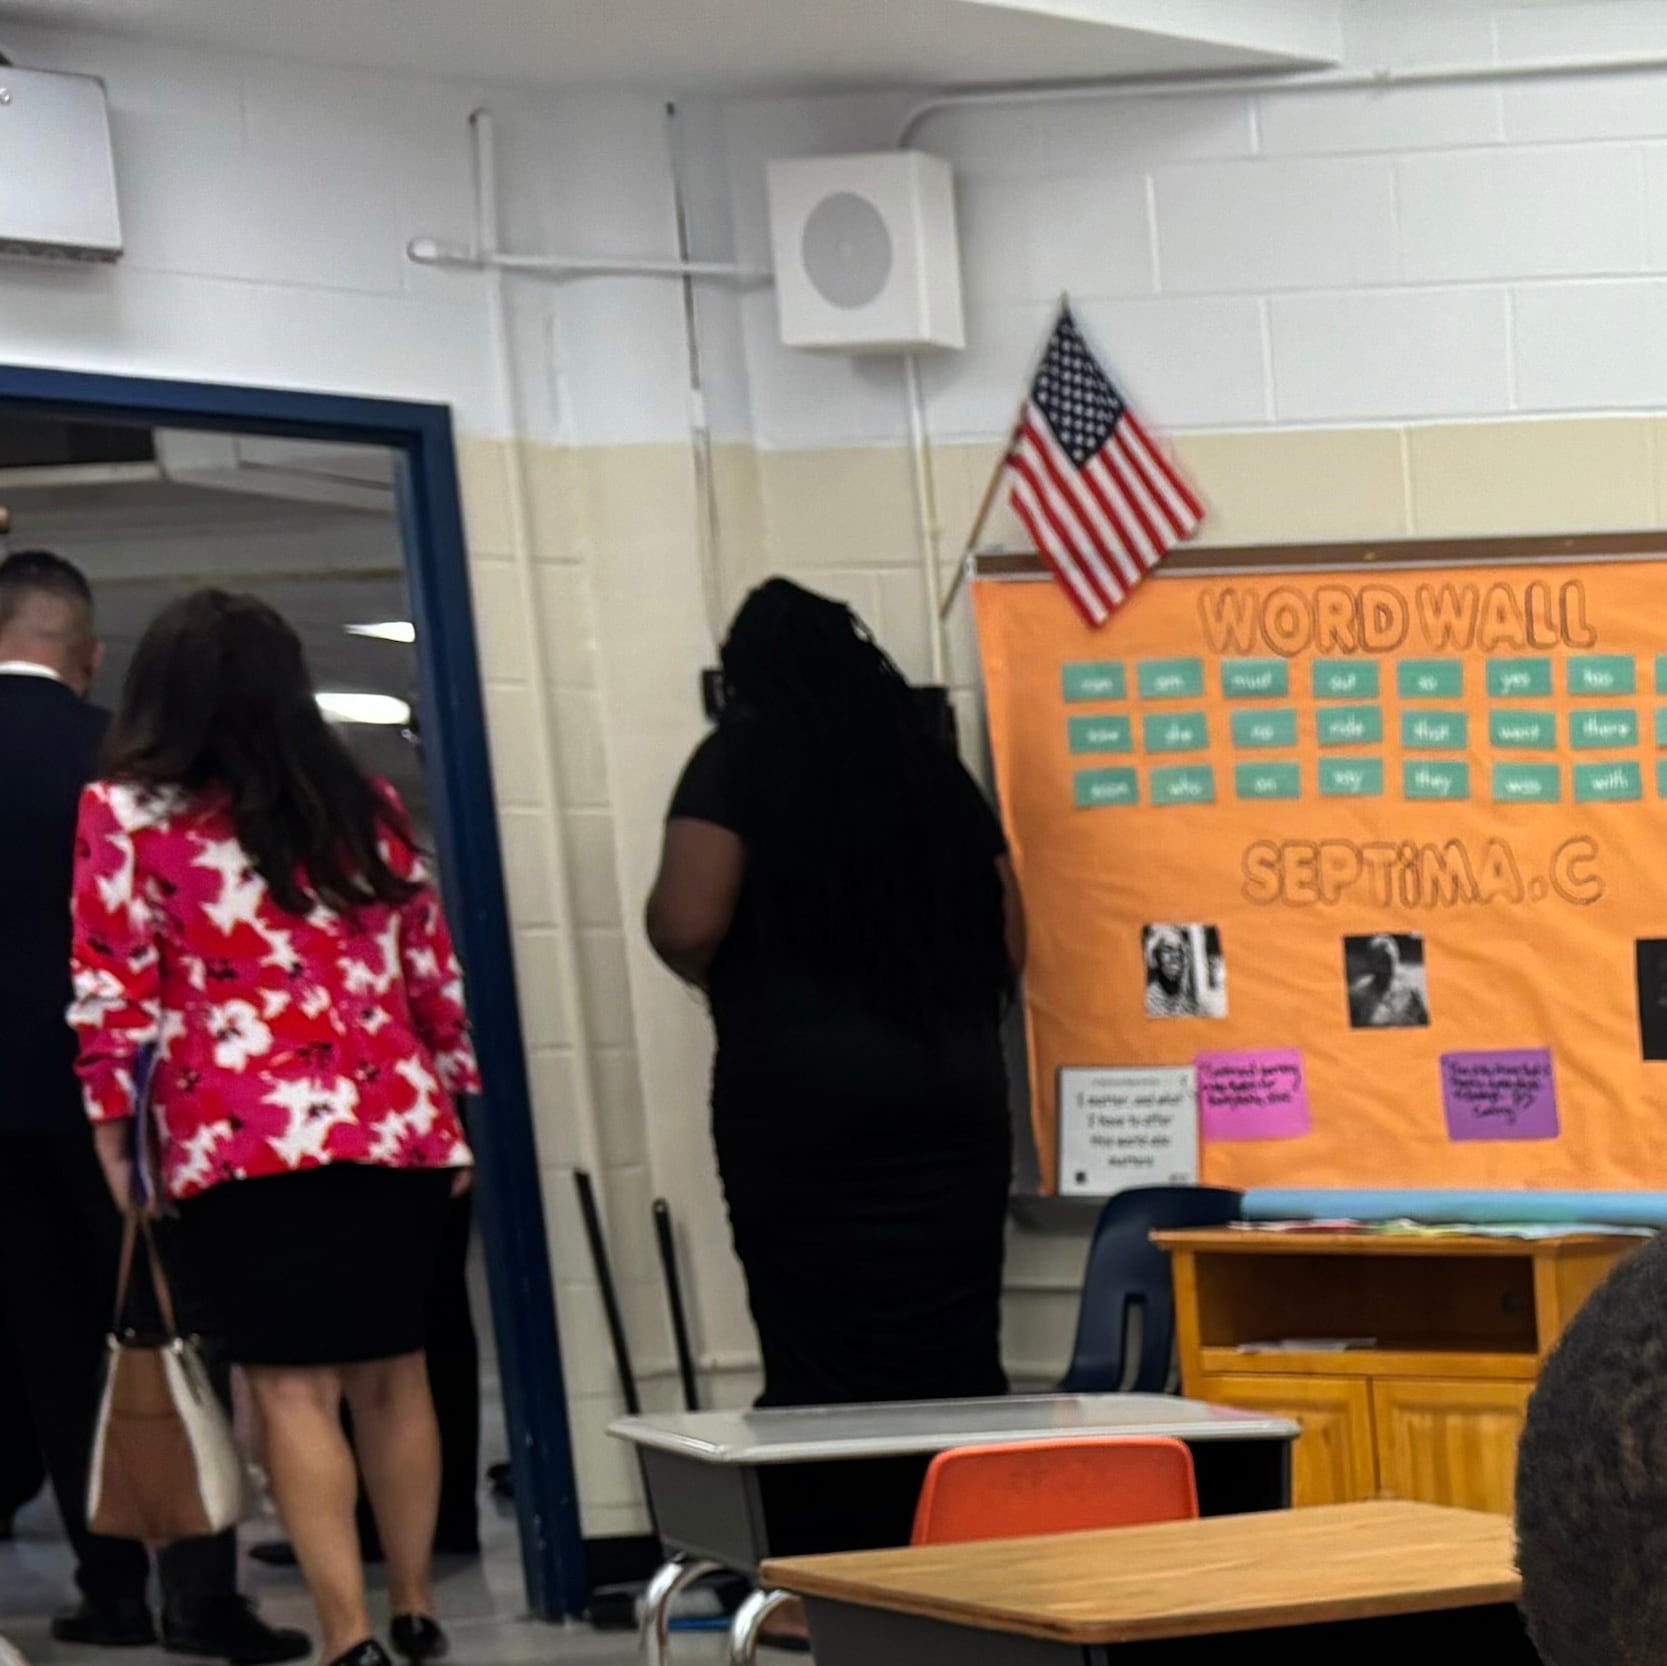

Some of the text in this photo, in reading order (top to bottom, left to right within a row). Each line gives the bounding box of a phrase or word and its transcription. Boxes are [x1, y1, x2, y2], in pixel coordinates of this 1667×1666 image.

[1199, 579, 1598, 657] WORD WALL
[1499, 669, 1531, 694] yes
[1329, 714, 1364, 737] ride
[1413, 721, 1450, 741] that
[1498, 722, 1540, 741] went
[1582, 717, 1631, 738] there
[1414, 771, 1452, 795] they
[1592, 768, 1629, 791] with
